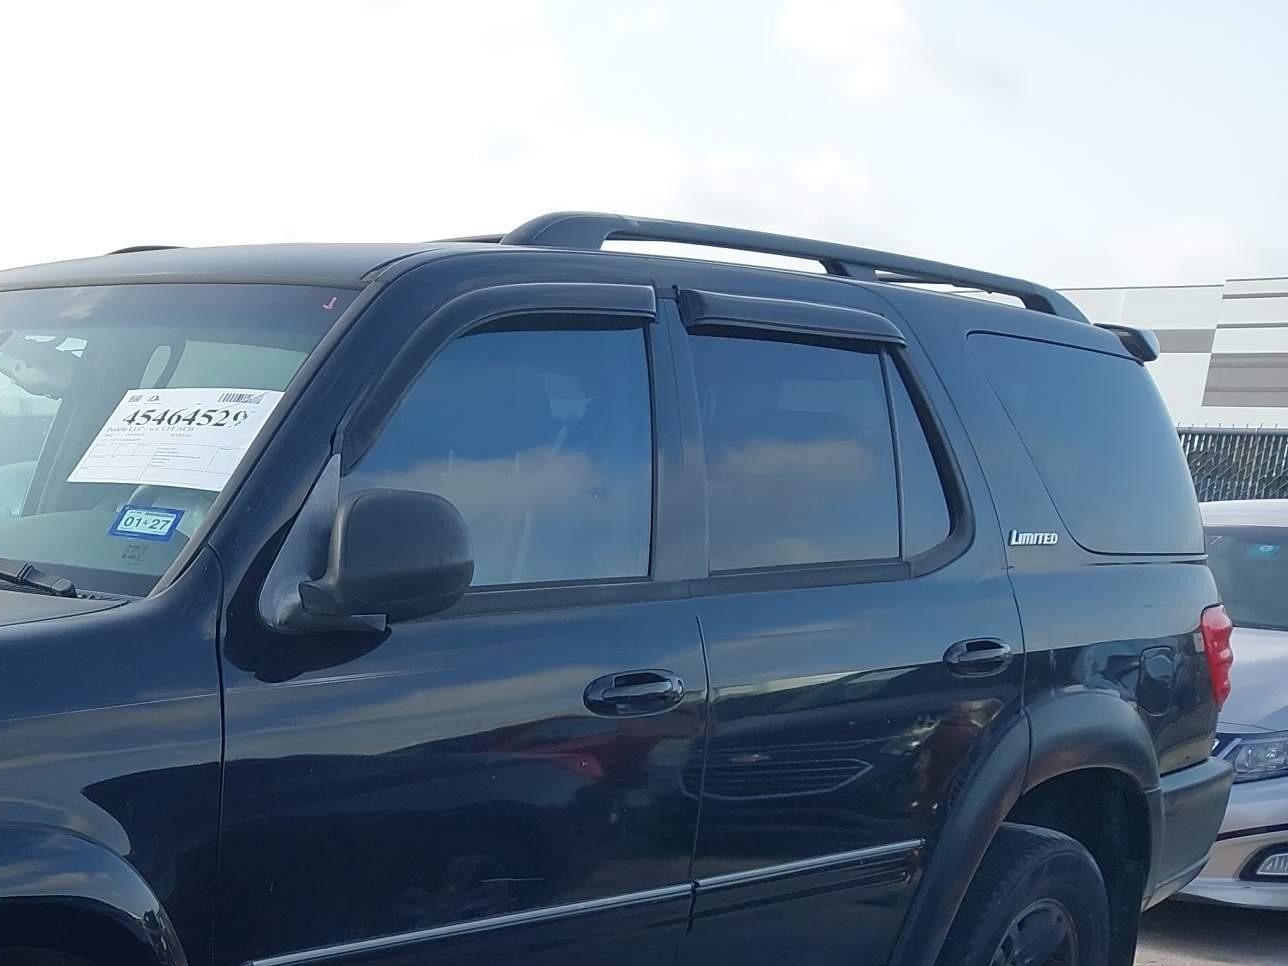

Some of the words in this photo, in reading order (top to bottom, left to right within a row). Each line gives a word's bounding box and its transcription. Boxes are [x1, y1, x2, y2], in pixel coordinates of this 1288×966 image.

[123, 408, 249, 427] 45464529
[123, 516, 143, 528] 01
[148, 518, 172, 530] 27
